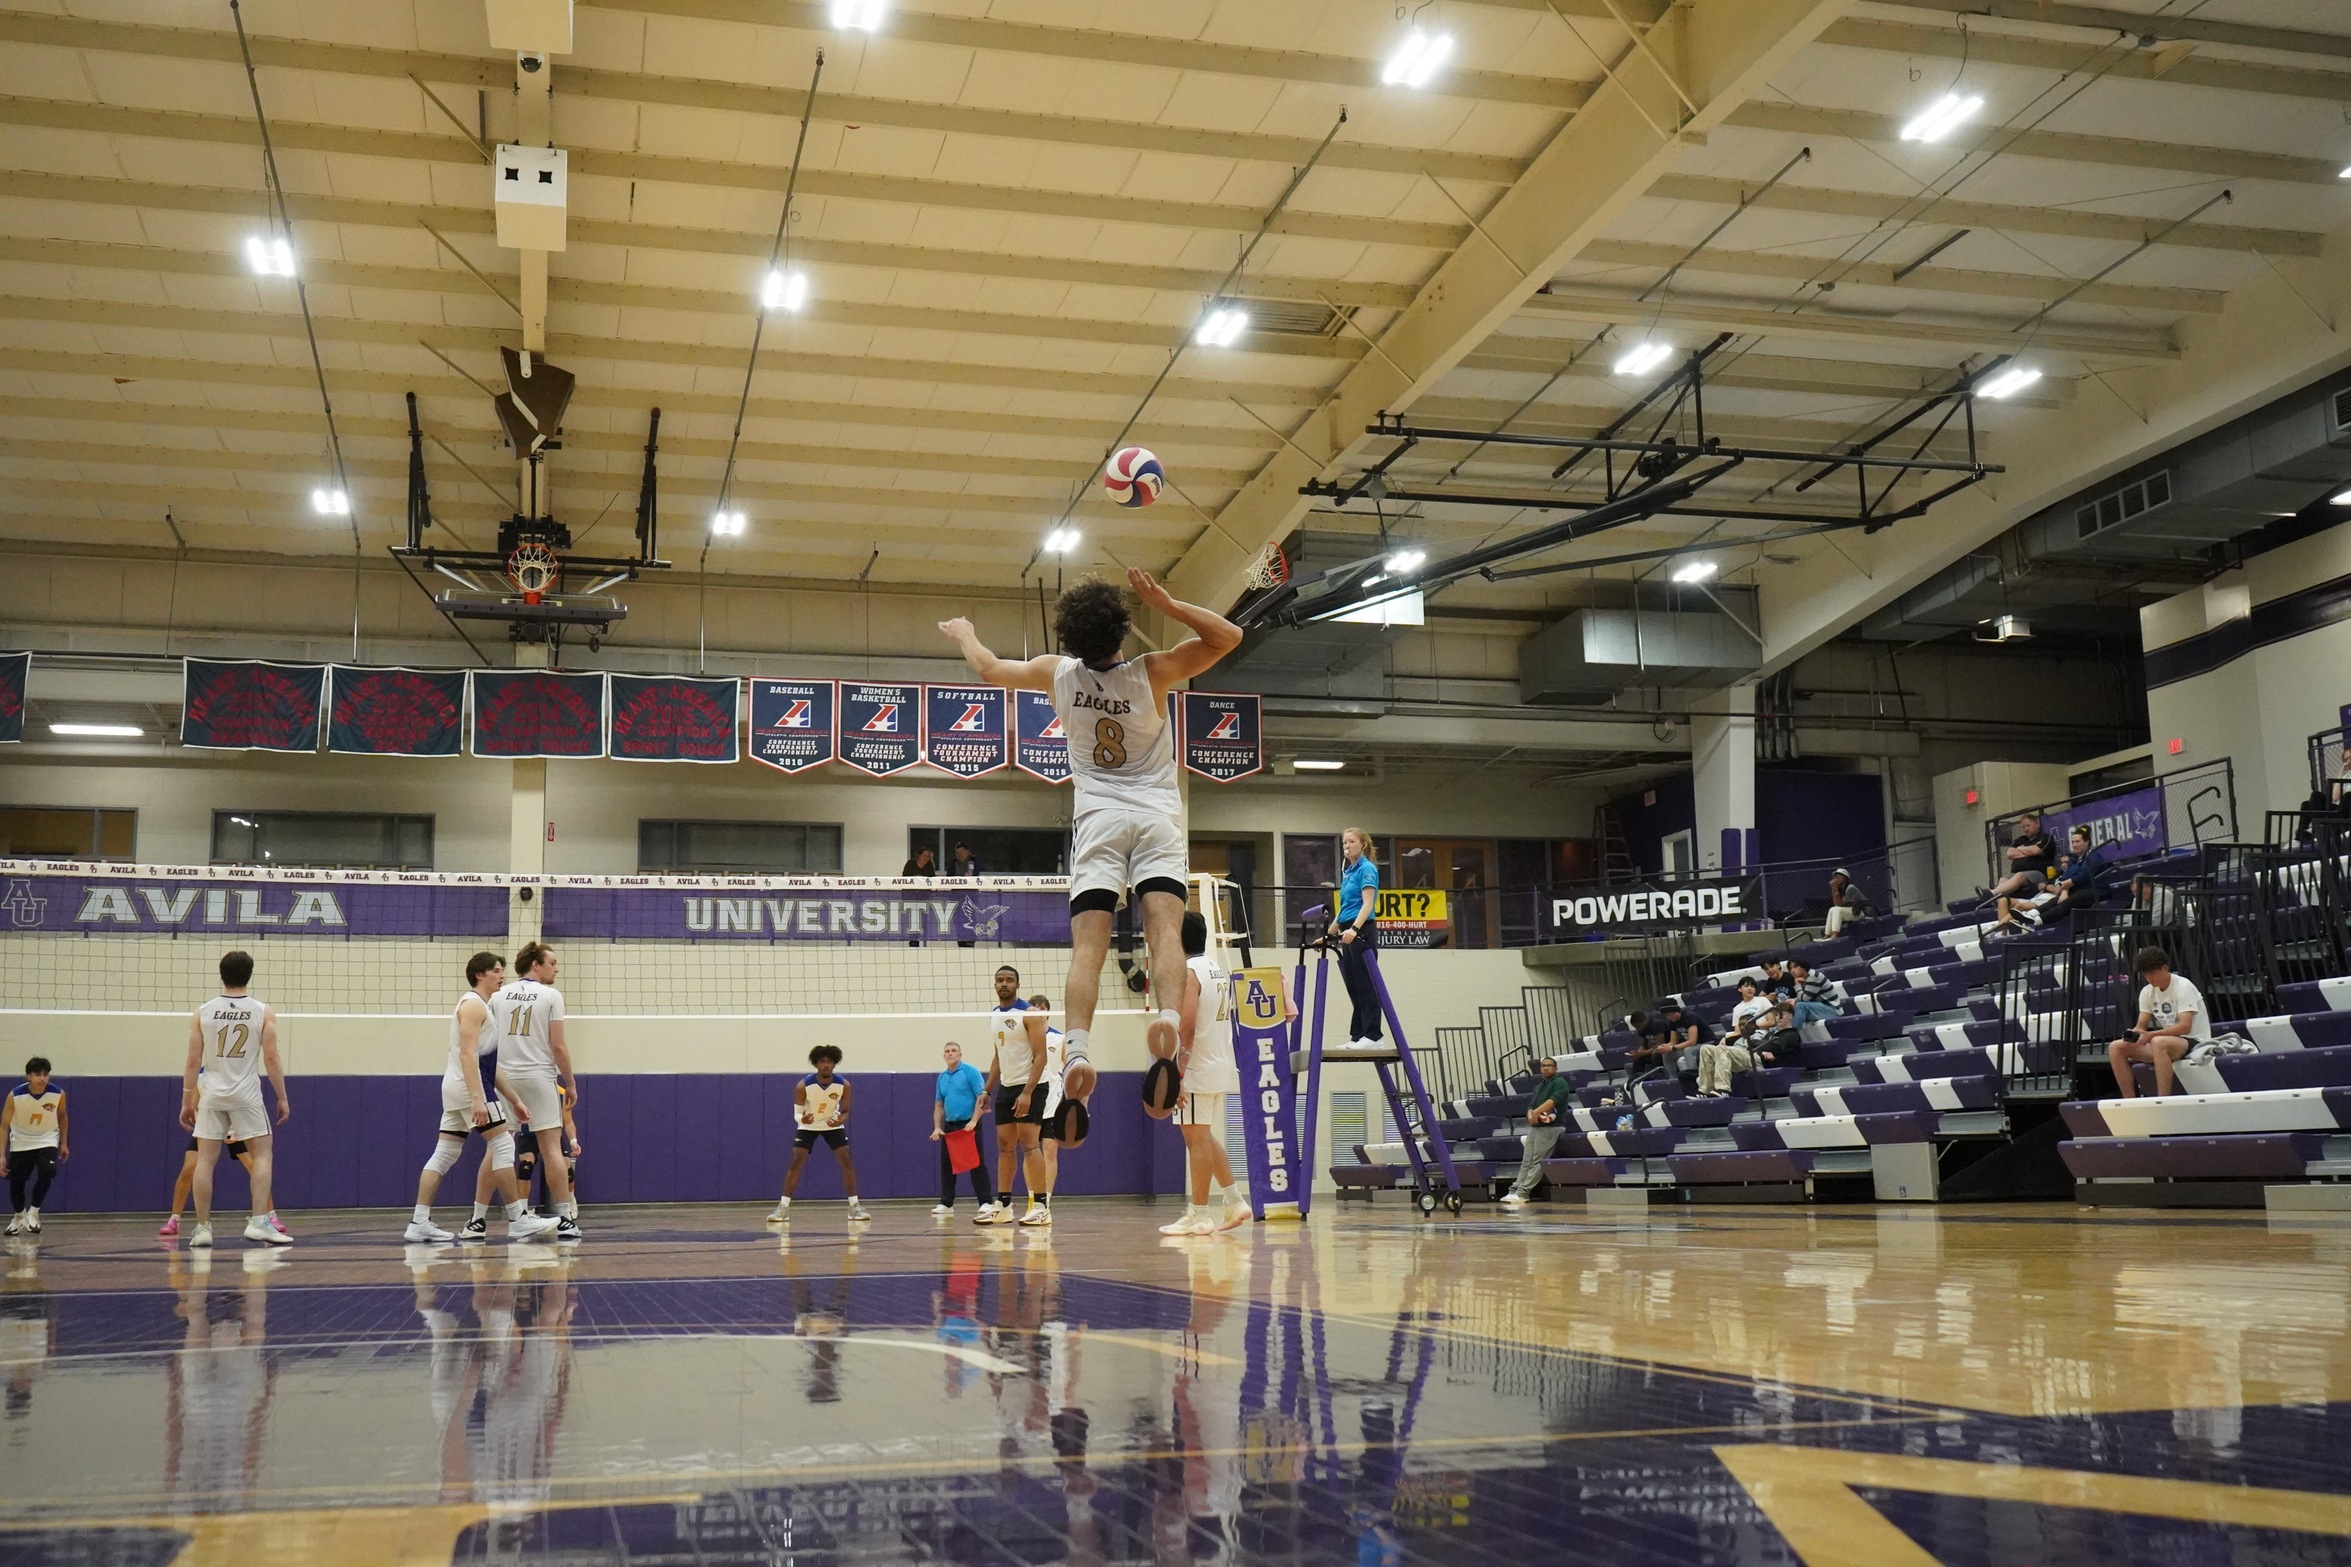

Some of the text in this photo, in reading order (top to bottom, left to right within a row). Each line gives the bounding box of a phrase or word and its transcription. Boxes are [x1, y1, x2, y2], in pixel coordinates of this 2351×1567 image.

[250, 666, 314, 727] AMERICA
[769, 686, 815, 695] BASEBALL
[937, 691, 996, 700] SOFTBALL
[333, 672, 457, 728] HEART AMERICA
[373, 693, 422, 714] 2012
[851, 694, 907, 704] BASKETBALL
[1072, 691, 1131, 715] EAGLES
[1210, 701, 1235, 709] DANCE
[478, 678, 598, 734] HEART AMERICA
[614, 686, 658, 735] HEART
[669, 683, 731, 739] AMERICA
[514, 703, 561, 723] 2014
[648, 705, 695, 724] 2015
[358, 713, 434, 727] CHAMPION
[500, 724, 575, 737] CHAMPION
[638, 725, 710, 738] CHAMPION
[486, 740, 591, 752] SPIRIT SQUAD
[622, 741, 725, 756] SPIRIT SQUAD
[1093, 717, 1127, 769] 8
[850, 752, 905, 760] CHAMPIONSHIP
[933, 749, 998, 757] TOURNAMENT
[940, 755, 989, 763] CHAMPION
[1023, 748, 1067, 757] CONFERE
[1192, 750, 1254, 758] CONFERENCE
[779, 758, 803, 766] 2010
[867, 761, 890, 769] 2011
[1029, 756, 1067, 764] CHAMPI
[954, 764, 979, 772] 2015
[1043, 768, 1066, 776] 2016
[47, 863, 79, 872] EAGLES
[110, 866, 137, 874] AVILA
[167, 868, 198, 876] EAGLES
[284, 871, 315, 879] EAGLES
[1, 879, 348, 927] AU AVILA
[1374, 893, 1430, 917] URT?
[1553, 886, 1742, 927] POWERADE
[683, 897, 960, 934] UNIVERSITY
[1378, 936, 1430, 946] JURY LAW
[505, 992, 538, 1002] EAGLES
[1246, 980, 1276, 1018] AU
[213, 1011, 252, 1020] EAGLES
[507, 1004, 533, 1036] 11
[216, 1023, 249, 1058] 12
[818, 1103, 828, 1114] 2
[1257, 1037, 1289, 1192] EAGLES
